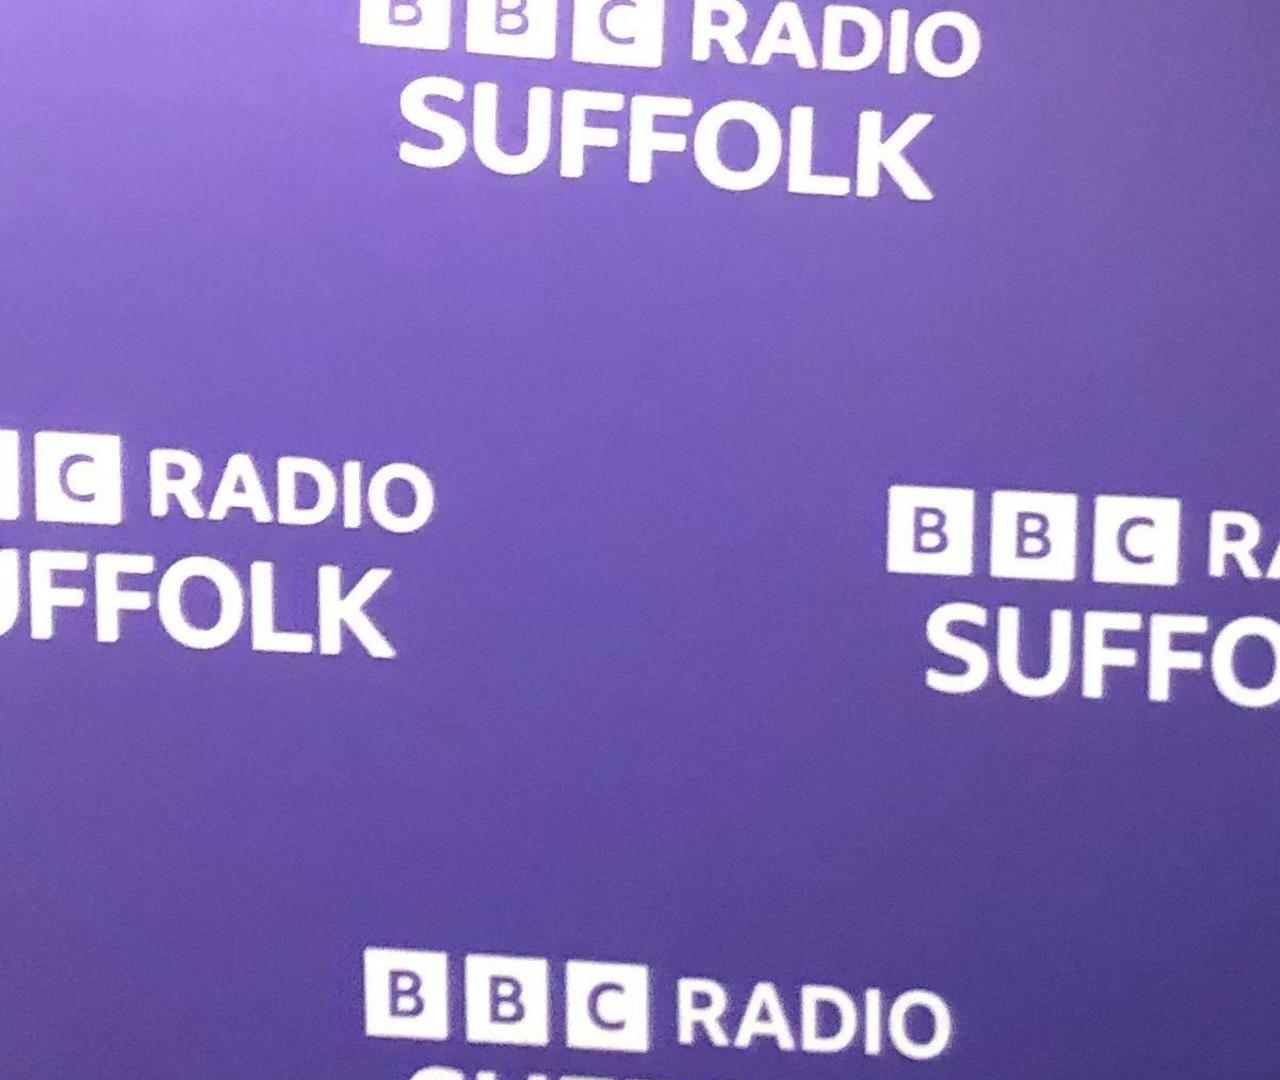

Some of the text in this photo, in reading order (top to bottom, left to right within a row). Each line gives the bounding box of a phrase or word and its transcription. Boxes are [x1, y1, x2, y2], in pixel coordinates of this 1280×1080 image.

[692, 0, 982, 78] RADIO
[398, 76, 935, 200] SUFFOLK
[149, 448, 434, 534] RADIO
[886, 485, 1179, 586] BBC
[0, 548, 397, 659] FFOLK
[363, 947, 952, 1060] BBC RADIO
